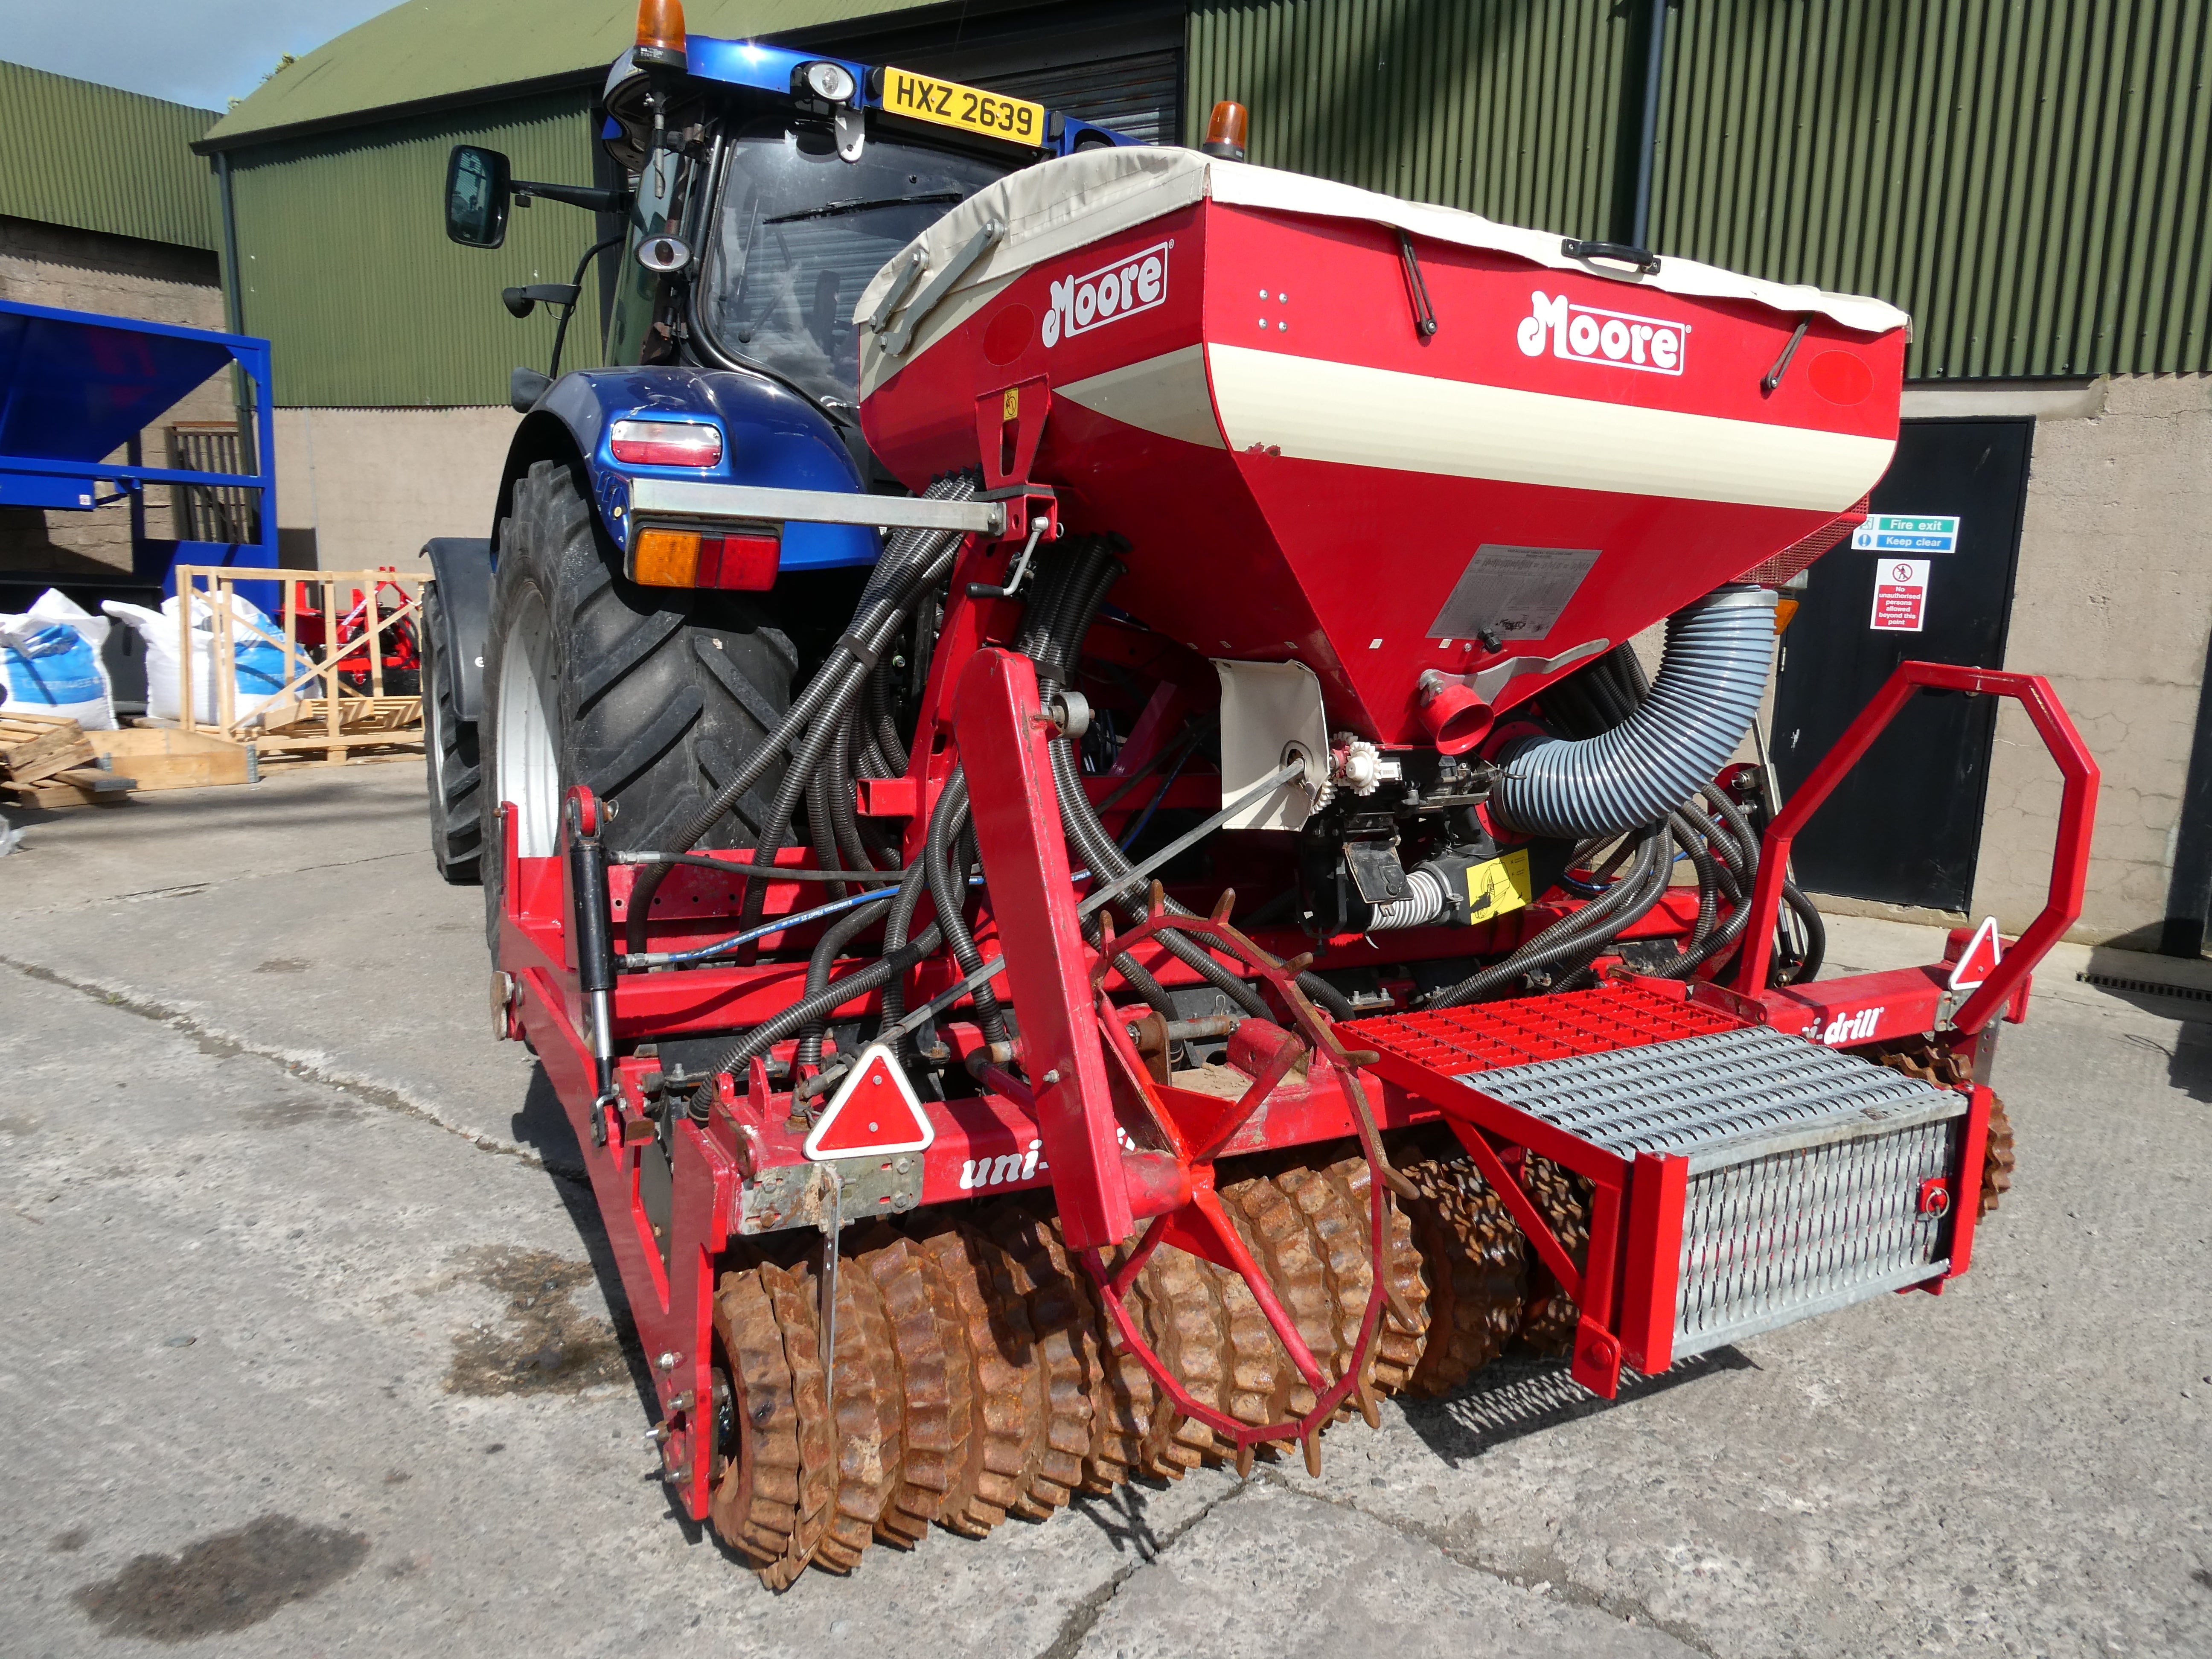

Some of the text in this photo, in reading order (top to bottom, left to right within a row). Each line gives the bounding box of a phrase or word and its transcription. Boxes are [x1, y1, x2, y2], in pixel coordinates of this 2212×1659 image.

[897, 76, 1033, 136] HXZ 2639
[1042, 256, 1162, 348] Moore
[1517, 290, 1679, 369] Moore
[1886, 536, 1941, 547] Keep clear
[1890, 519, 1942, 531] Fire exit
